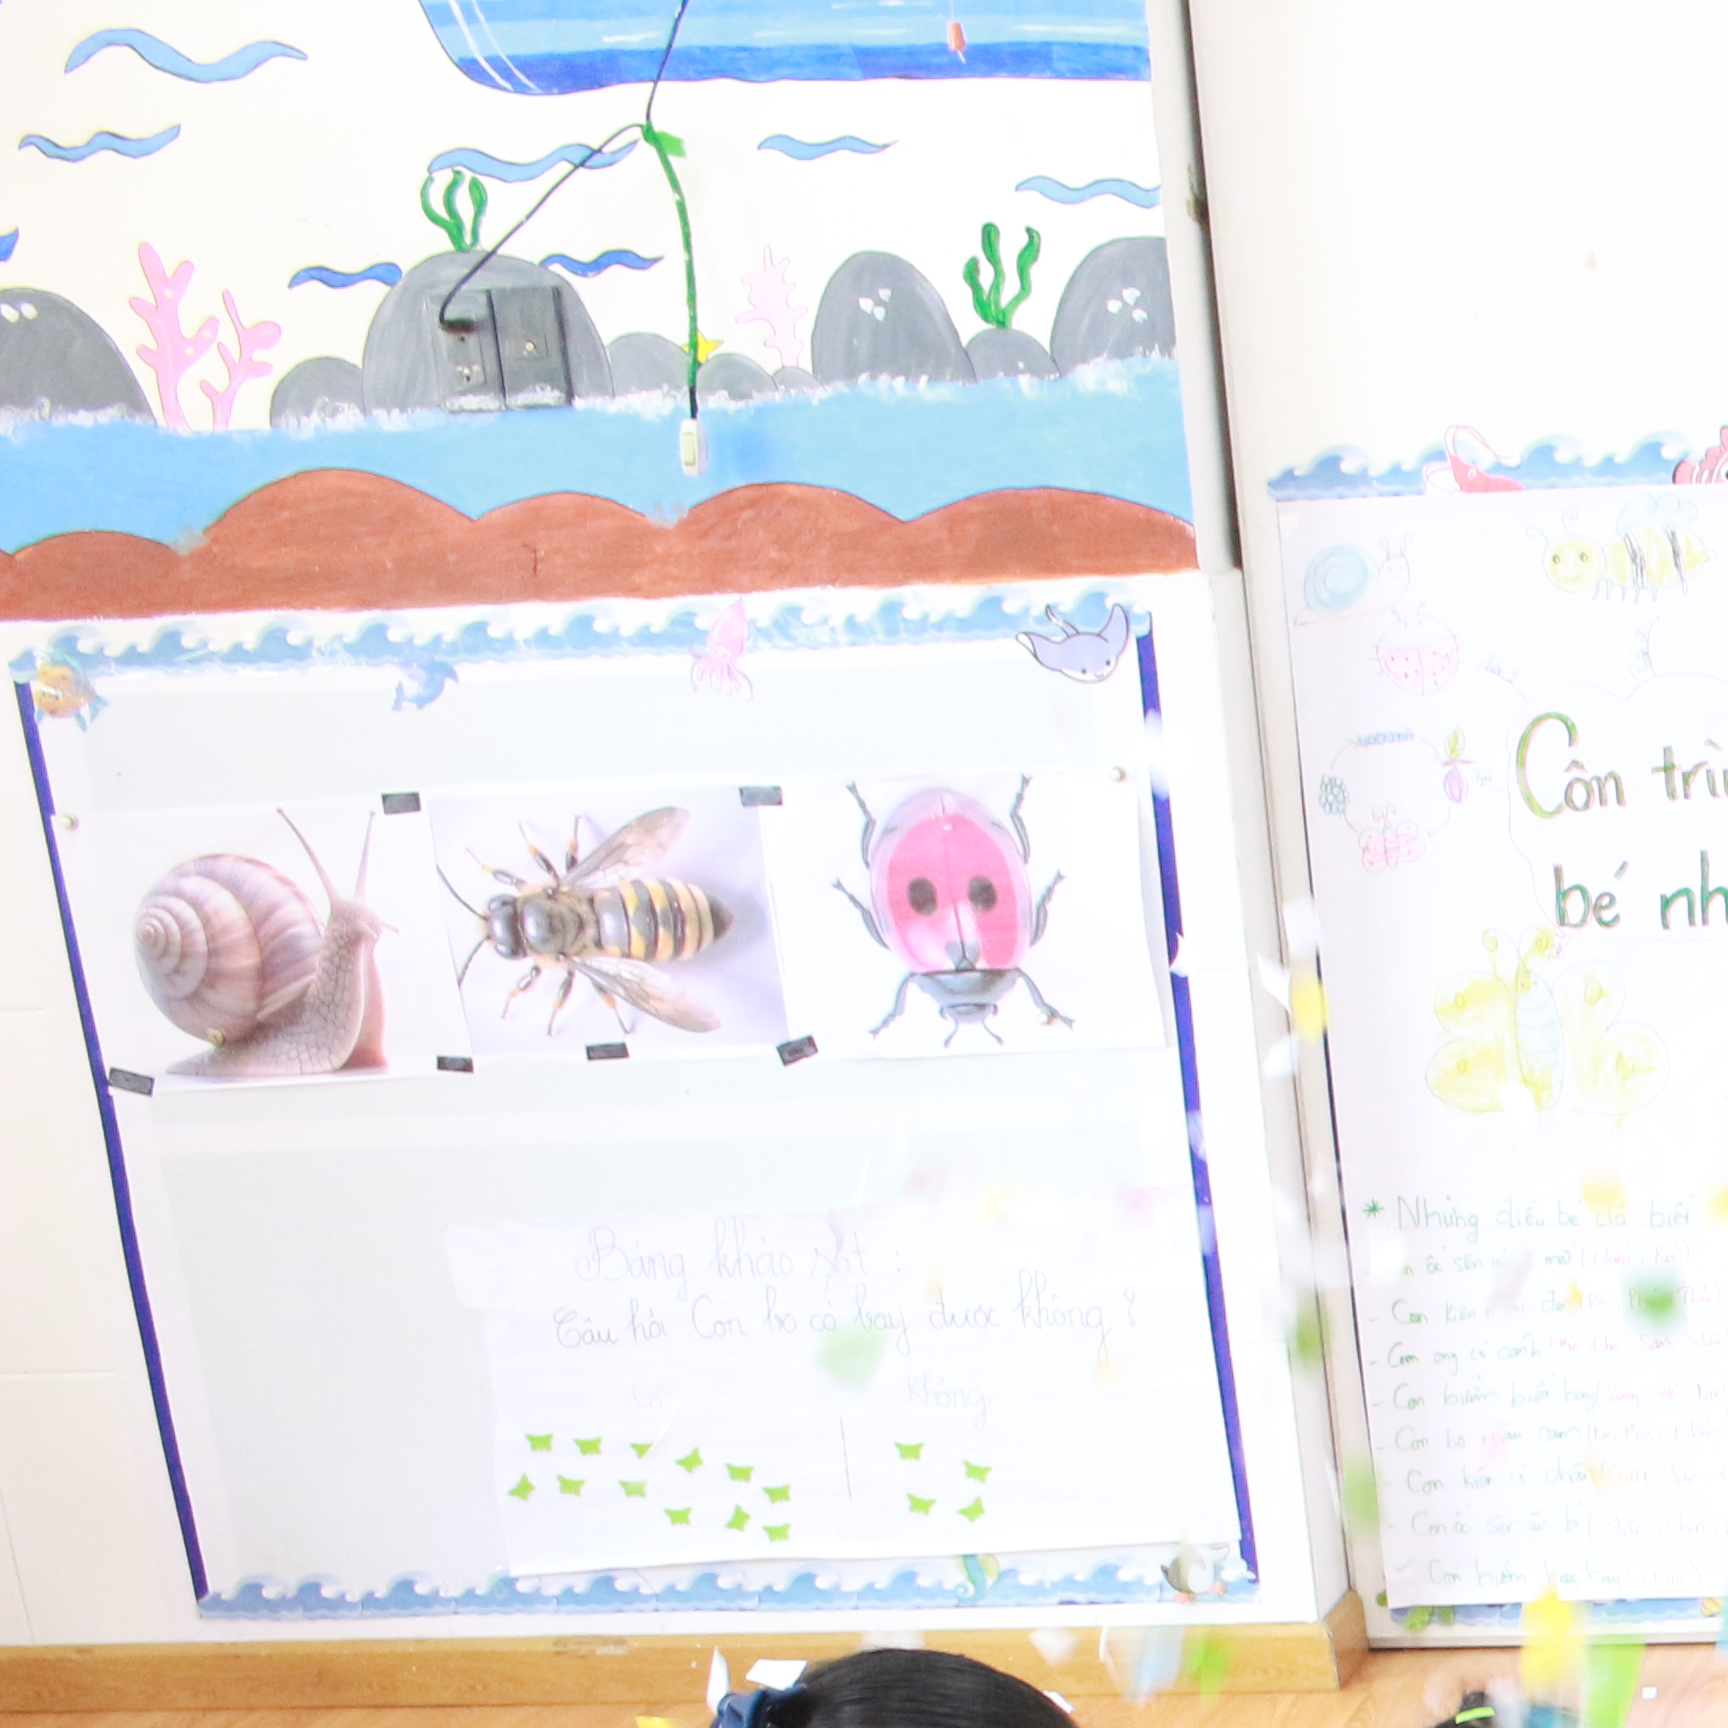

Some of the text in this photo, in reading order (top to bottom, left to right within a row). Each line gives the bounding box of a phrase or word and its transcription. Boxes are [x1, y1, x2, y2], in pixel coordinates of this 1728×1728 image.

[1514, 709, 1628, 820] Côn
[1552, 859, 1631, 930] bé
[575, 1225, 688, 1302] Bảng
[691, 1293, 748, 1340] Con
[853, 1281, 912, 1358] bay
[1012, 1266, 1113, 1368] không
